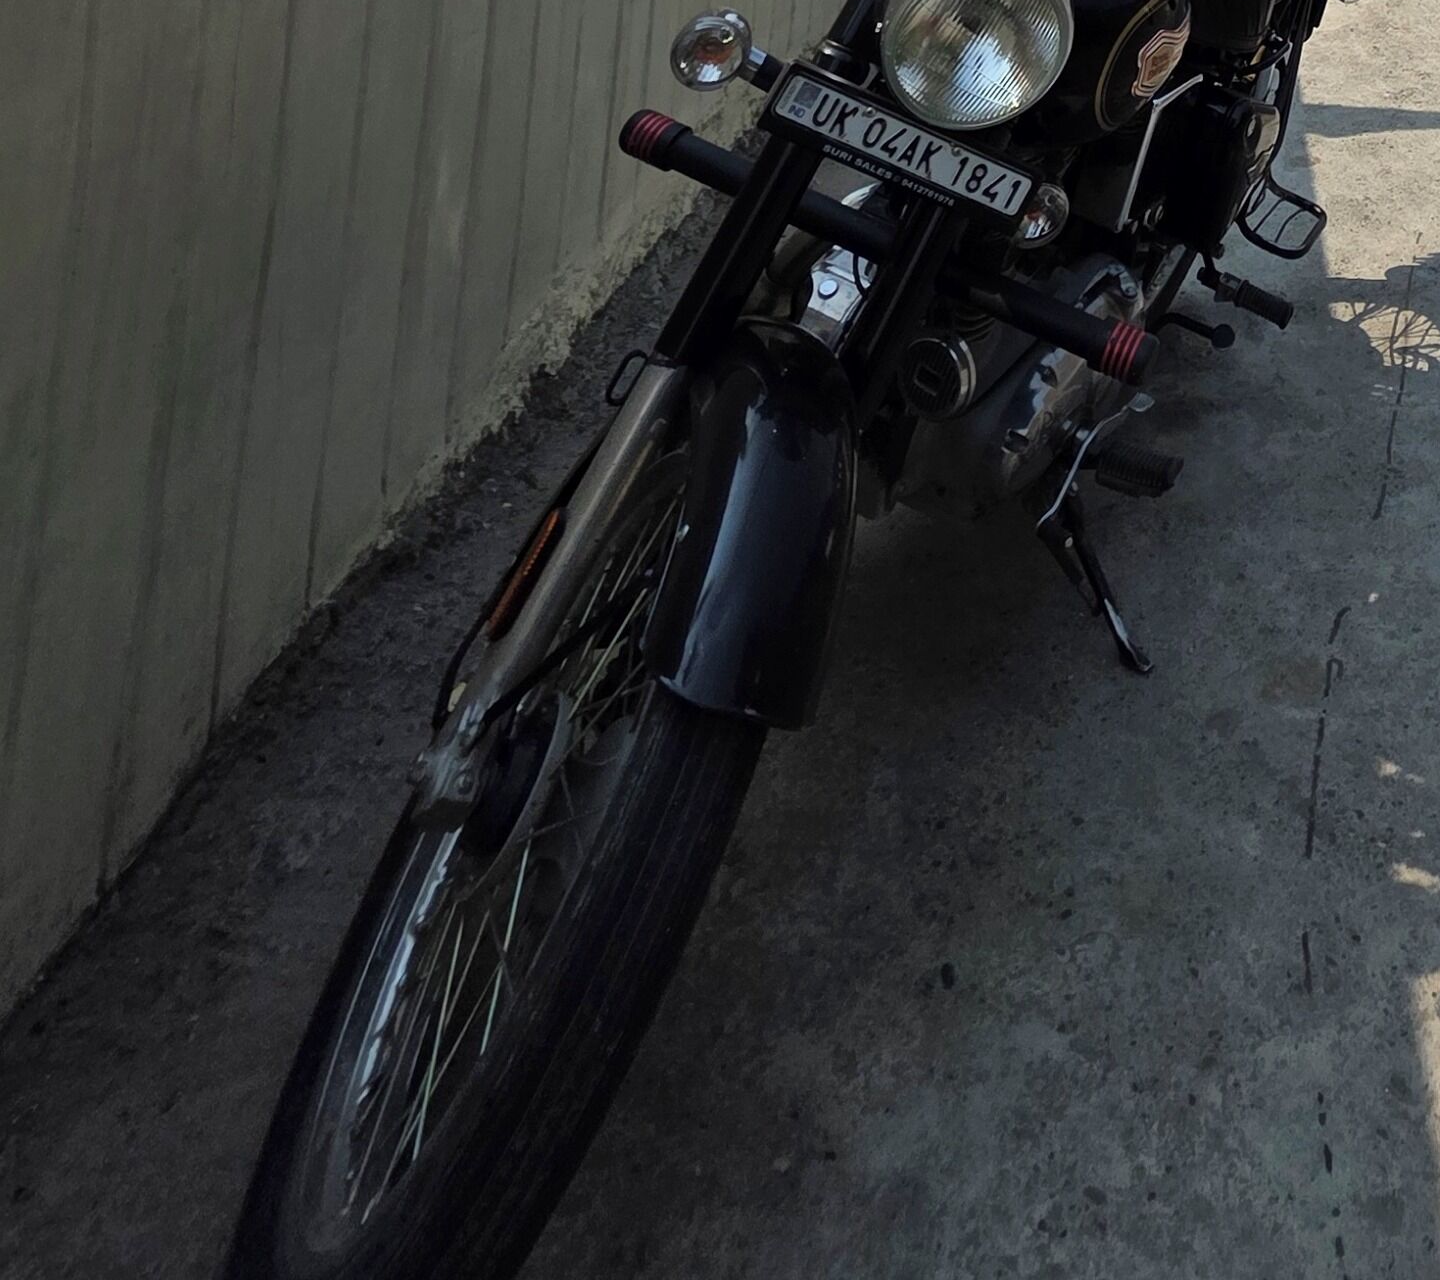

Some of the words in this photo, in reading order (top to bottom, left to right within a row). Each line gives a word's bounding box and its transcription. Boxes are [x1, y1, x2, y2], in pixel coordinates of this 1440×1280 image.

[811, 93, 859, 138] UK
[951, 156, 1023, 210] 1841
[822, 143, 852, 163] SURI
[853, 157, 893, 181] SALES
